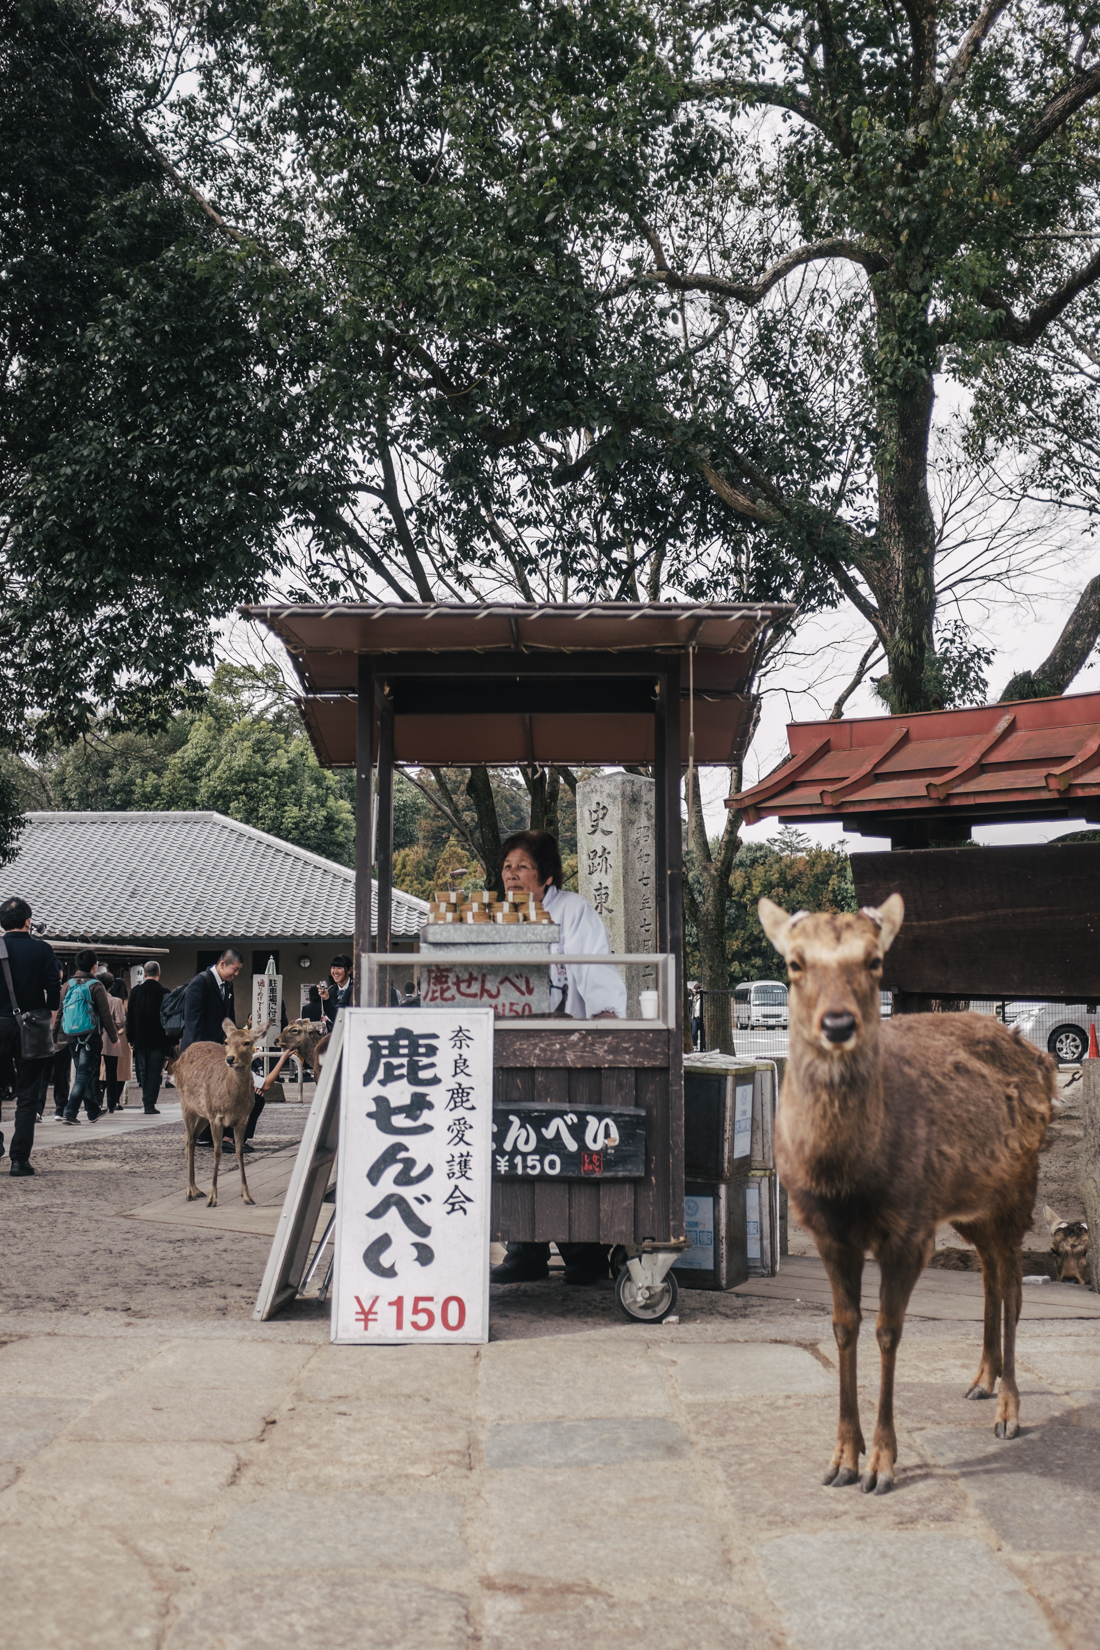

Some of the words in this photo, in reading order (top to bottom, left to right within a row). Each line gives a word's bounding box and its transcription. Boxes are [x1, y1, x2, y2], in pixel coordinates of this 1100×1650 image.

[442, 1025, 477, 1216] 奈良鹿愛護会
[492, 1112, 620, 1153] んべい
[362, 1027, 443, 1279] 鹿せんべい
[495, 1153, 562, 1176] ¥150
[354, 1295, 467, 1332] ¥150
